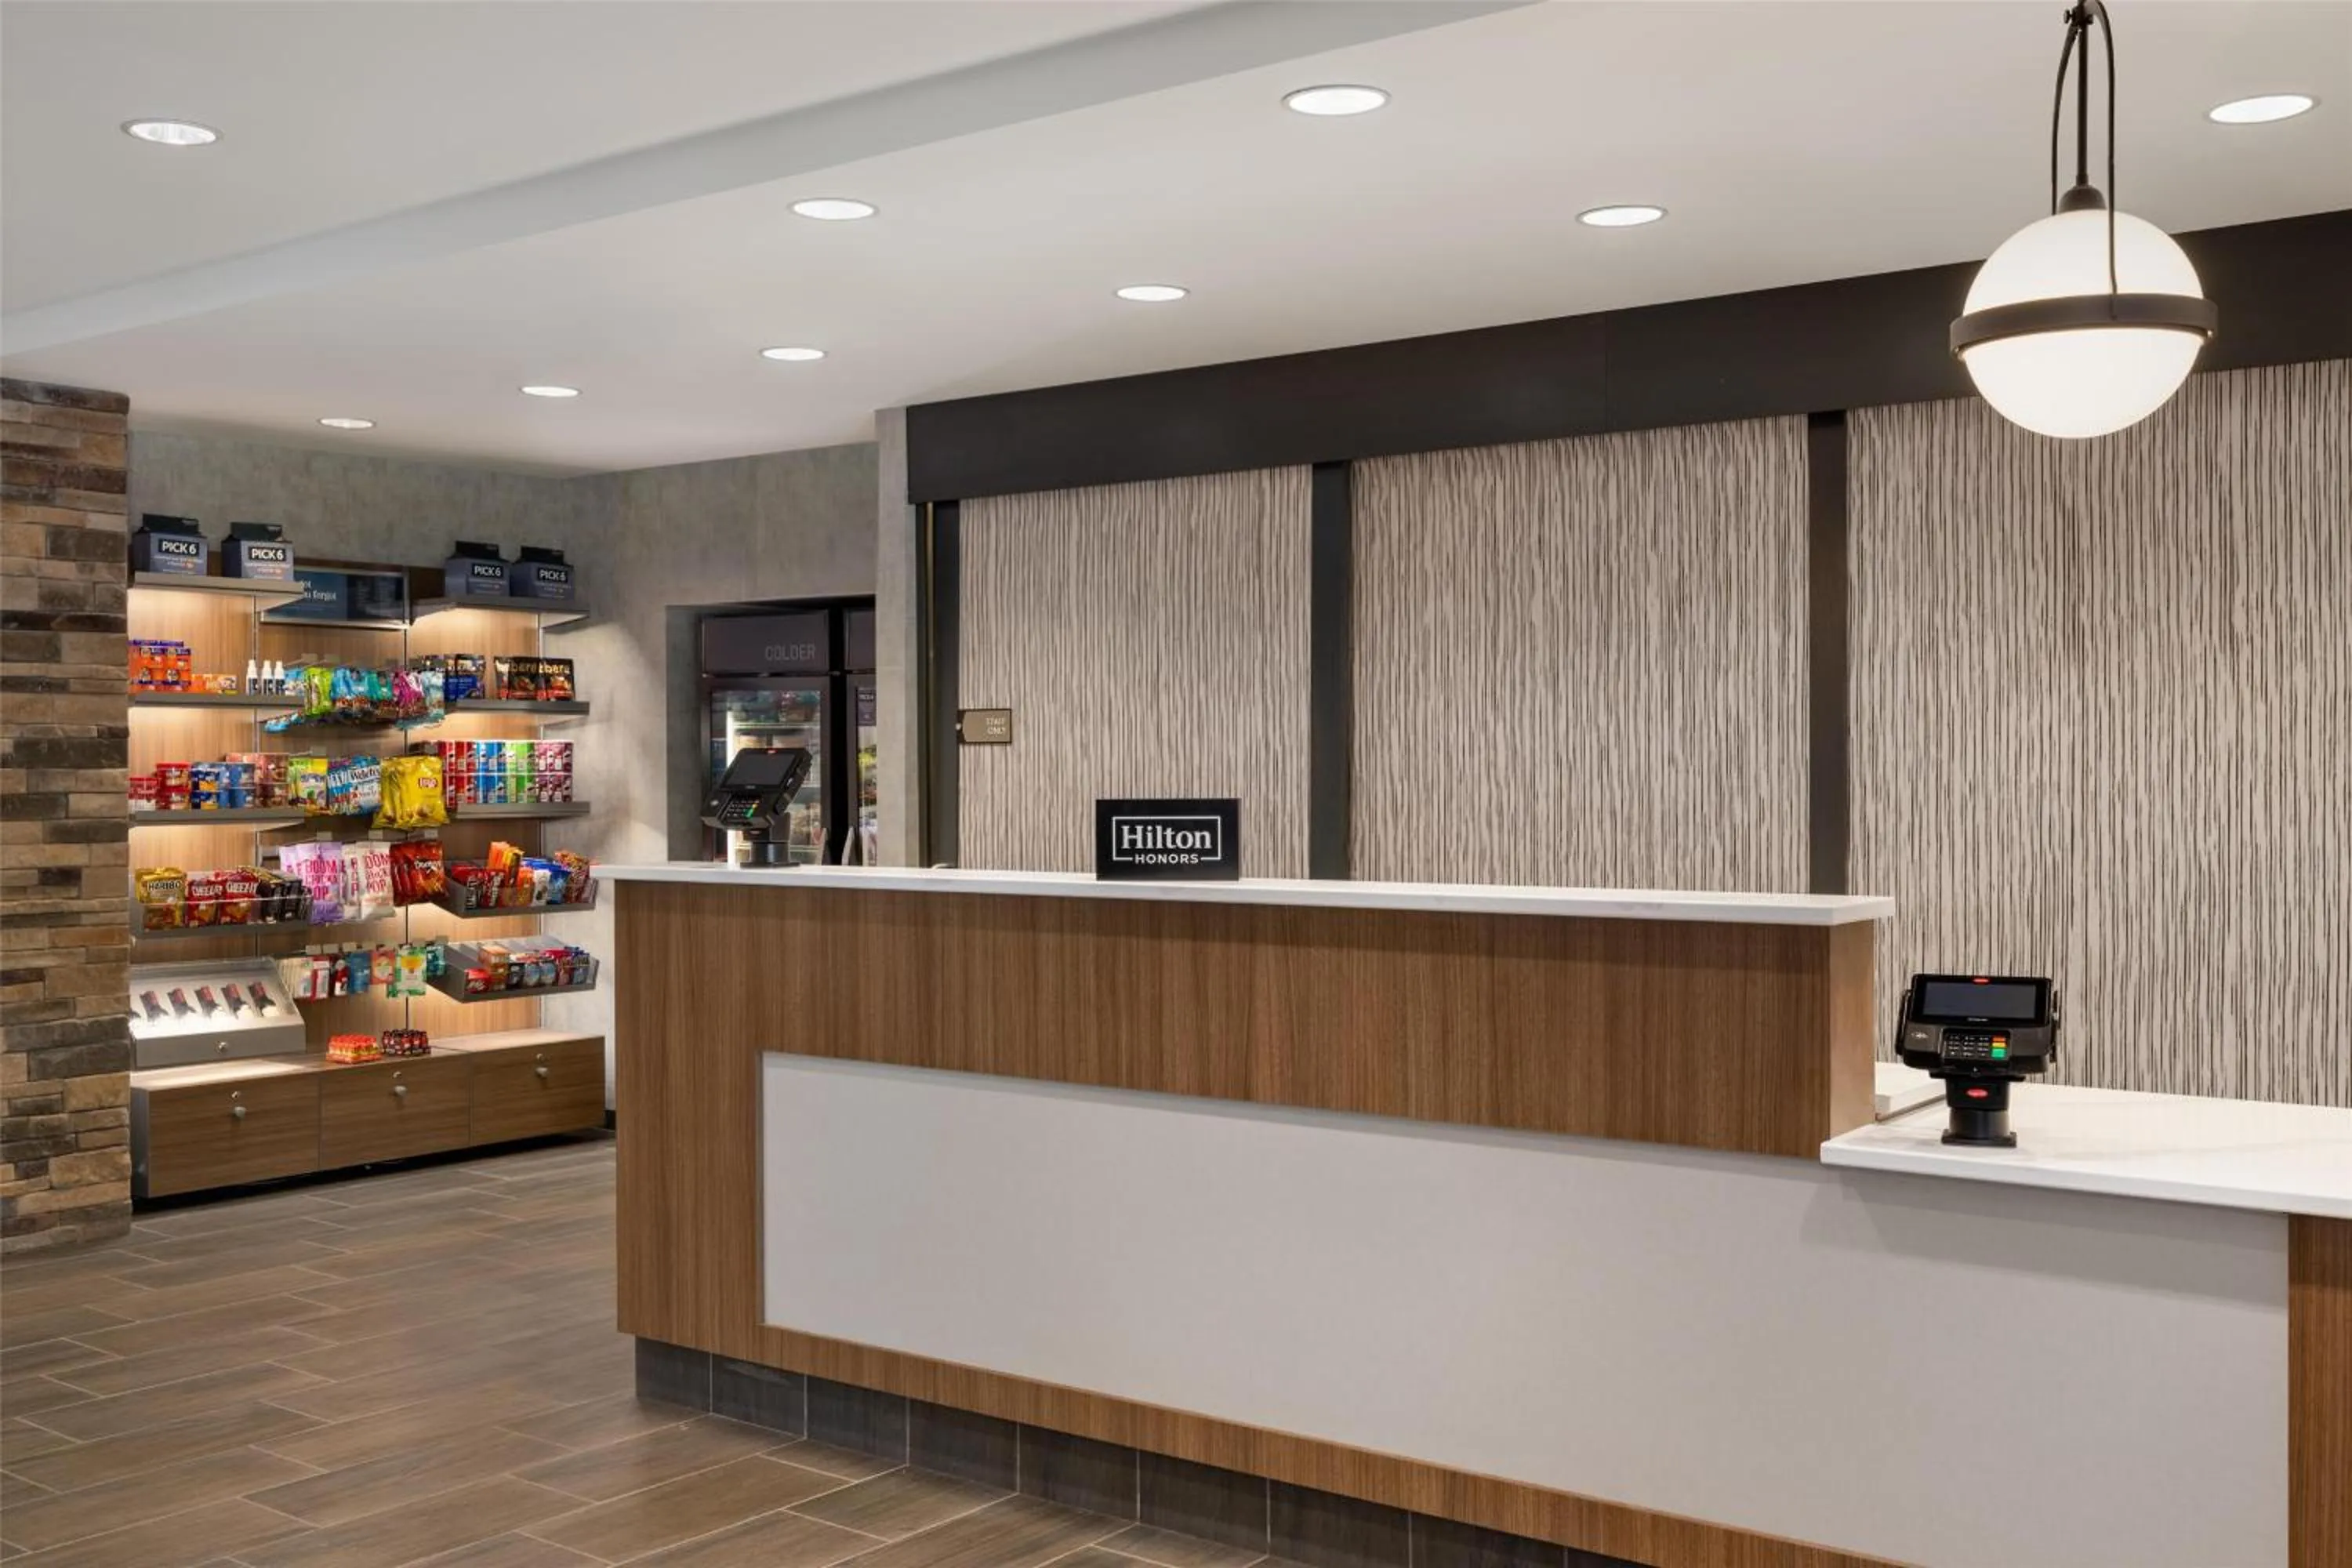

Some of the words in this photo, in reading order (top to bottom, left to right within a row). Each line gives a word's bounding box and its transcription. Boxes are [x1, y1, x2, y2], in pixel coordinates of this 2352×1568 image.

[162, 541, 188, 554] PICK
[189, 543, 197, 554] 6
[251, 548, 275, 560] PICK
[276, 550, 285, 560] 6
[474, 565, 495, 576] PICK
[495, 567, 502, 576] 6
[539, 569, 559, 581] PICK
[765, 644, 816, 661] COLDER
[1121, 825, 1212, 849] Hilton
[1134, 854, 1199, 864] HONORS
[147, 880, 182, 891] HARIBO
